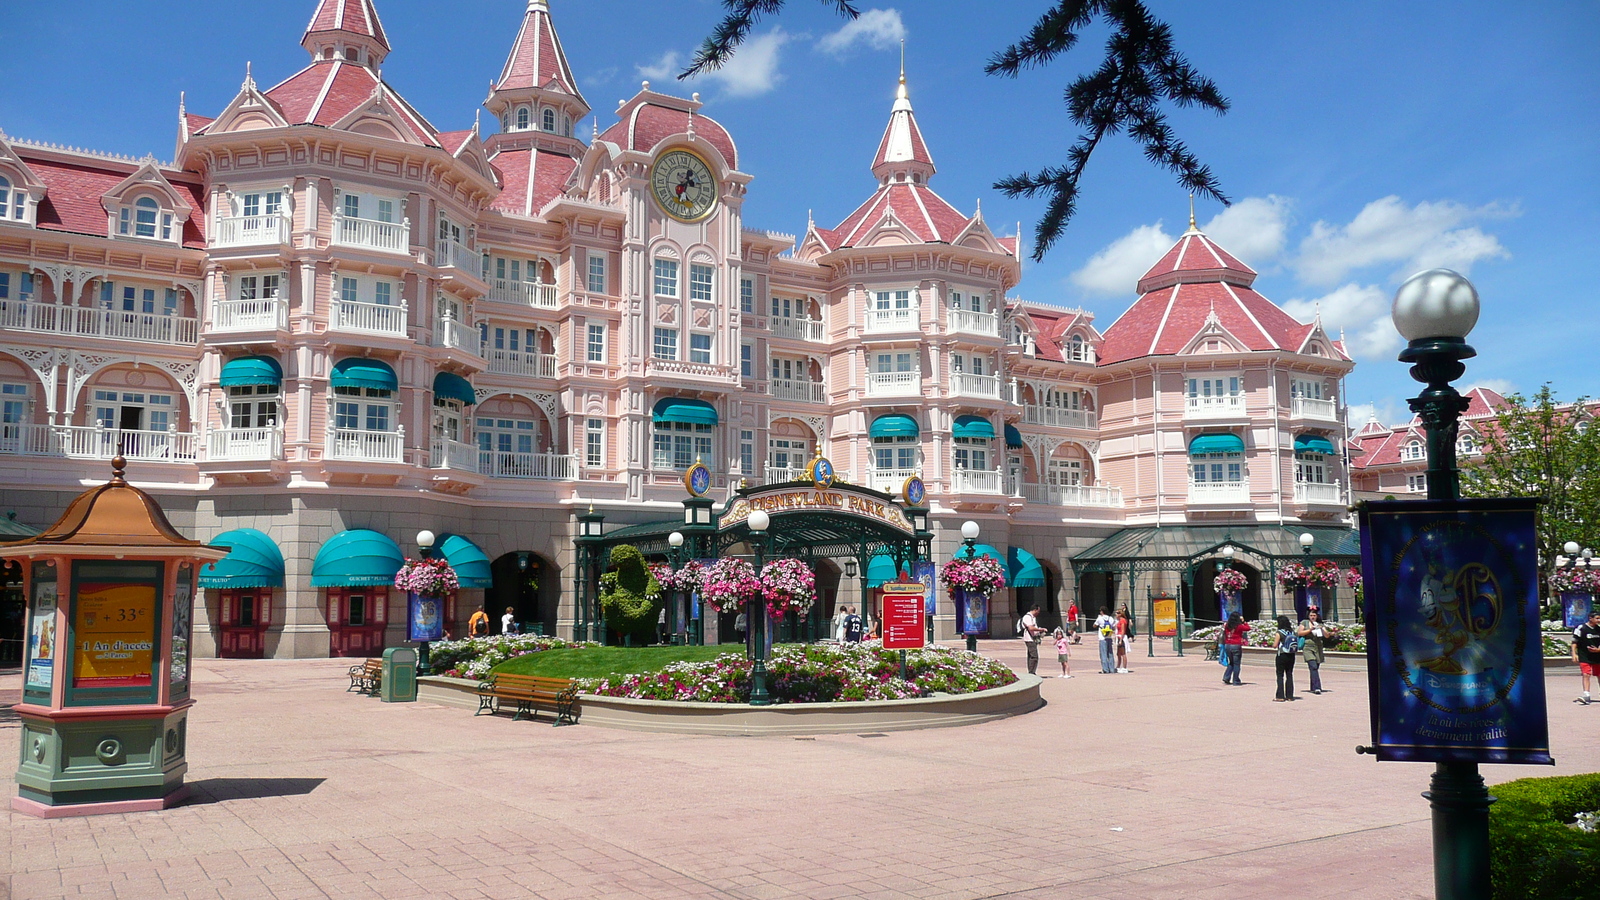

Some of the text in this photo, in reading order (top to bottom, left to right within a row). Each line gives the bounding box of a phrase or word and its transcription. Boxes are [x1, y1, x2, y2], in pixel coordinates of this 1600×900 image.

[749, 491, 886, 518] DISNEYLAND PARK
[1418, 520, 1467, 532] Welcome
[1453, 562, 1503, 637] 15
[851, 623, 860, 632] 13
[94, 641, 109, 651] An
[113, 640, 152, 651] d'accès
[1428, 714, 1438, 725] là
[1440, 716, 1452, 727] où
[1454, 717, 1467, 728] les
[1415, 726, 1508, 742] deviennent réalité
